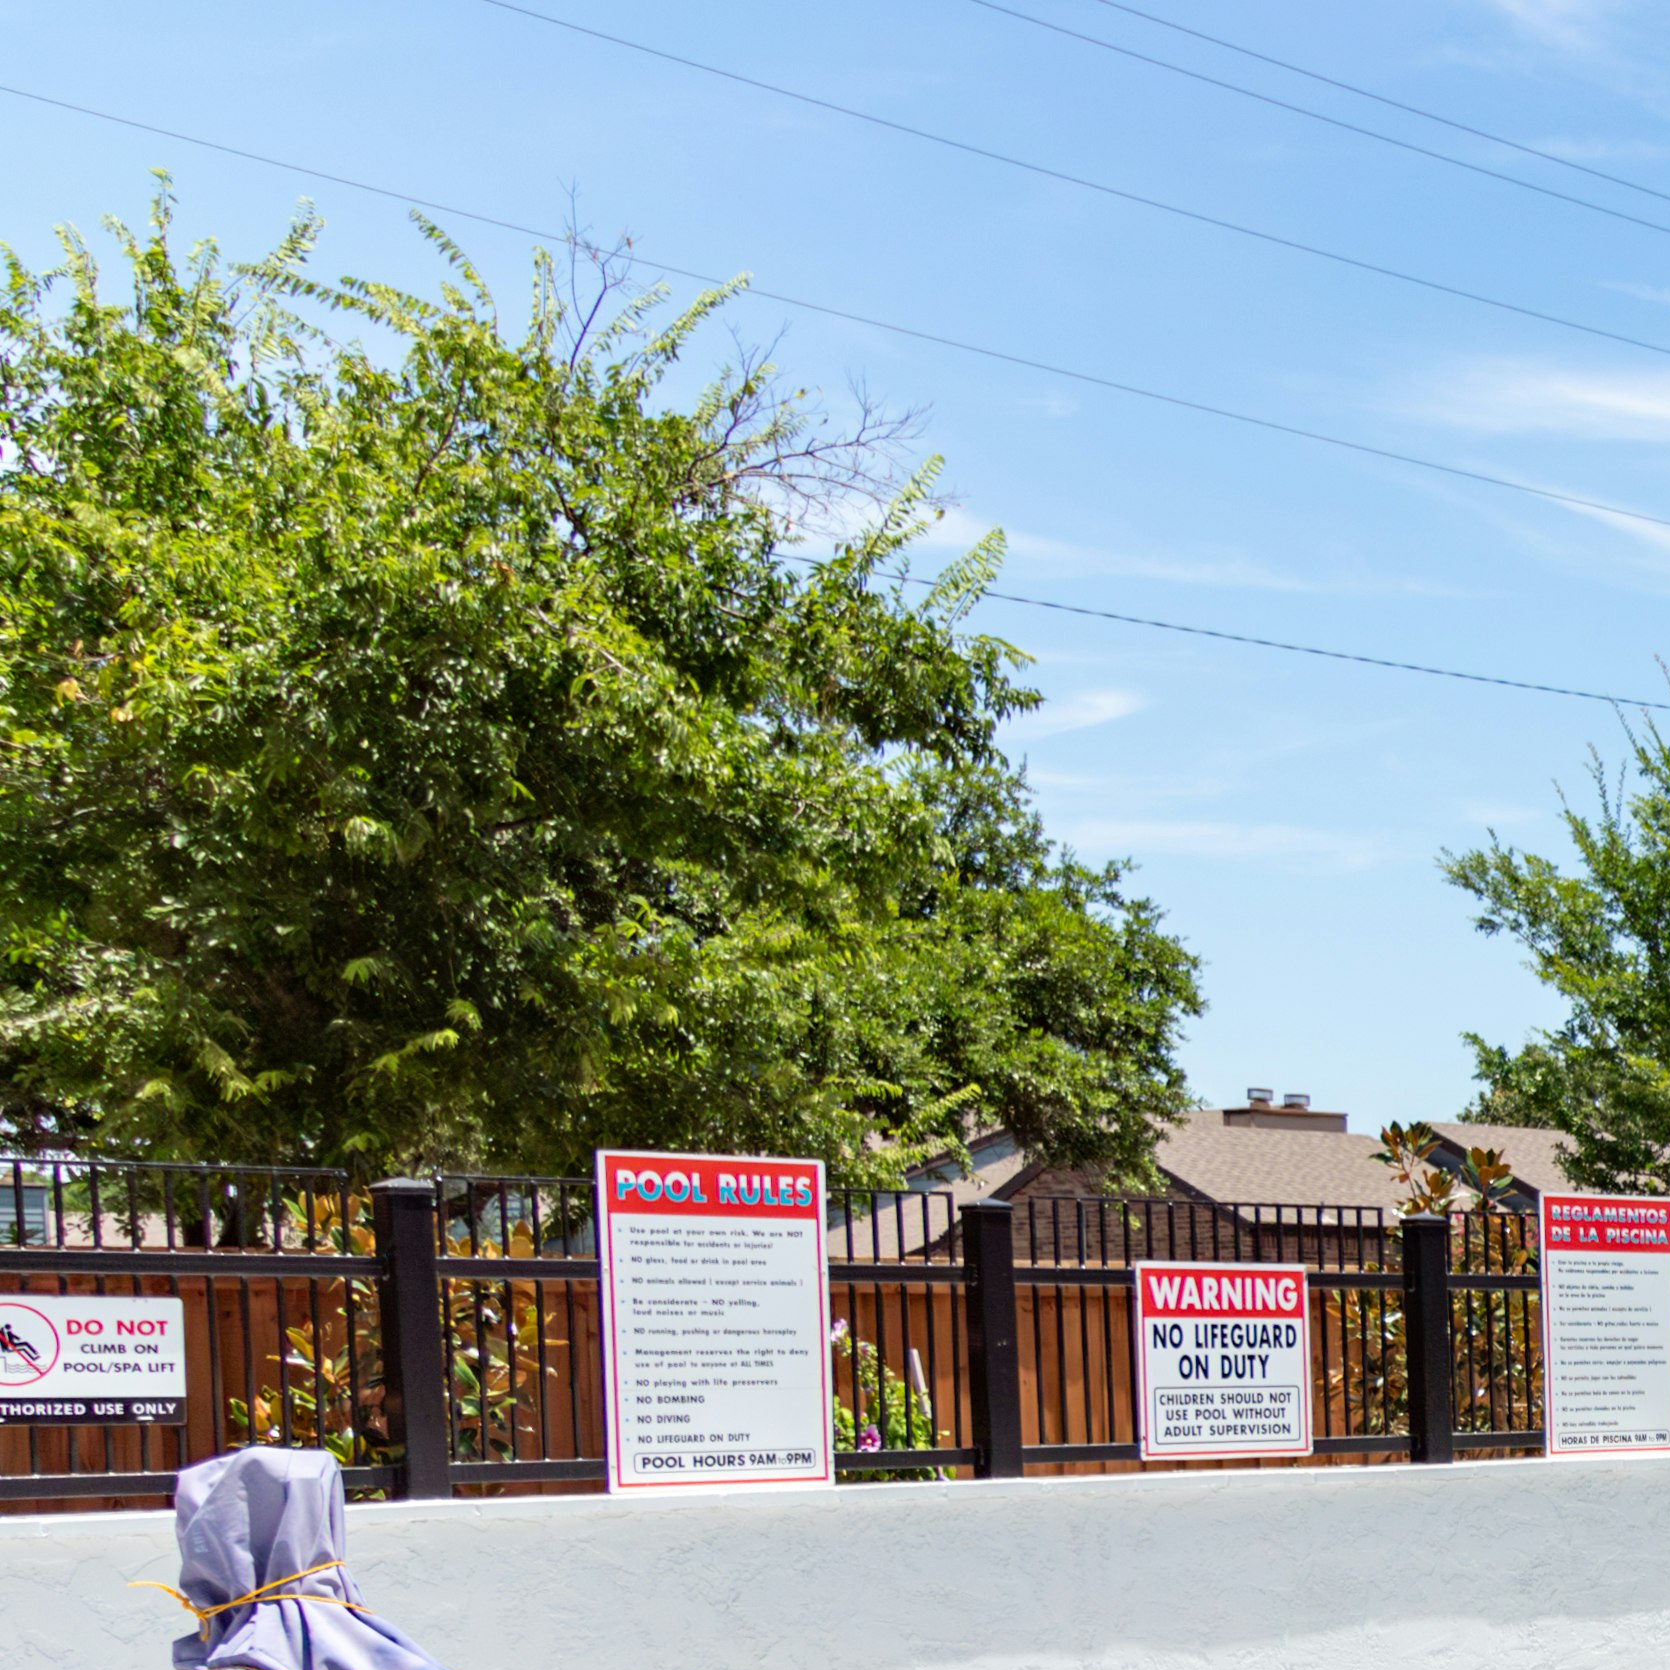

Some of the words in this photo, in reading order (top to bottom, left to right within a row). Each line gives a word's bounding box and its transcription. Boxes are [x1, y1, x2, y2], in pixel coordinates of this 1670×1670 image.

[617, 1169, 707, 1203] POOL
[719, 1174, 812, 1206] RULES
[1552, 1205, 1668, 1223] REGLAMENTOS
[650, 1227, 670, 1236] pool
[1552, 1226, 1571, 1242] DE
[1580, 1227, 1599, 1242] LA
[1607, 1228, 1668, 1244] PISCINA
[630, 1239, 681, 1248] responsible
[683, 1240, 694, 1248] for
[631, 1256, 643, 1264] NO
[671, 1256, 688, 1265] food
[701, 1257, 720, 1265] drink
[732, 1258, 748, 1266] pool
[632, 1277, 644, 1285] NO
[678, 1277, 706, 1286] allowed
[715, 1279, 740, 1287] except
[1149, 1276, 1298, 1311] WARNING
[632, 1297, 644, 1306] Be
[647, 1298, 698, 1306] considerate
[711, 1298, 726, 1306] NO
[632, 1308, 653, 1316] loud
[700, 1309, 725, 1317] music
[66, 1319, 104, 1336] DO
[116, 1320, 168, 1336] NOT
[634, 1327, 646, 1335] NO
[682, 1328, 710, 1337] pushing
[723, 1328, 760, 1337] dangerous
[763, 1328, 797, 1337] horseplay
[1153, 1323, 1184, 1350] NO
[1195, 1323, 1297, 1349] LIFEGUARD
[80, 1343, 127, 1354] CLIMB
[134, 1344, 159, 1355] ON
[634, 1348, 692, 1358] Management
[736, 1348, 751, 1356] the
[754, 1348, 774, 1357] right
[789, 1348, 809, 1356] deny
[63, 1362, 143, 1374] POOL/SPA
[148, 1362, 176, 1373] LIFT
[654, 1360, 664, 1368] of
[667, 1360, 687, 1369] pool
[740, 1360, 752, 1368] ALL
[754, 1360, 774, 1368] TIMES
[1178, 1354, 1209, 1380] ON
[1220, 1354, 1270, 1380] DUTY
[636, 1379, 650, 1387] NO
[653, 1379, 688, 1389] playing
[690, 1378, 710, 1386] with
[713, 1378, 728, 1386] life
[732, 1379, 778, 1388] preservers
[636, 1396, 653, 1405] NO
[657, 1395, 705, 1404] BOMBING
[1159, 1393, 1214, 1406] CHILDREN
[1220, 1392, 1264, 1405] SHOULD
[1269, 1392, 1292, 1404] NOT
[93, 1403, 124, 1416] USE
[131, 1402, 177, 1416] ONLY
[1166, 1409, 1188, 1422] USE
[1195, 1408, 1226, 1421] POOL
[1233, 1407, 1286, 1420] WITHOUT
[637, 1415, 652, 1424] NO
[657, 1414, 690, 1424] DIVING
[1164, 1425, 1203, 1438] ADULT
[1209, 1423, 1292, 1436] SUPERVISION
[637, 1435, 653, 1444] NO
[657, 1434, 706, 1444] LIFEGUARD
[709, 1434, 724, 1443] ON
[728, 1433, 751, 1442] DUTY
[1561, 1436, 1588, 1446] HORAS
[1590, 1435, 1599, 1444] DE
[1602, 1434, 1632, 1444] PISCINA
[1634, 1433, 1647, 1442] 9AM
[1656, 1433, 1667, 1441] 9PM
[642, 1456, 685, 1469] POOL
[693, 1454, 745, 1468] HOURS
[749, 1453, 777, 1466] 9AM
[787, 1452, 812, 1465] 9PM
